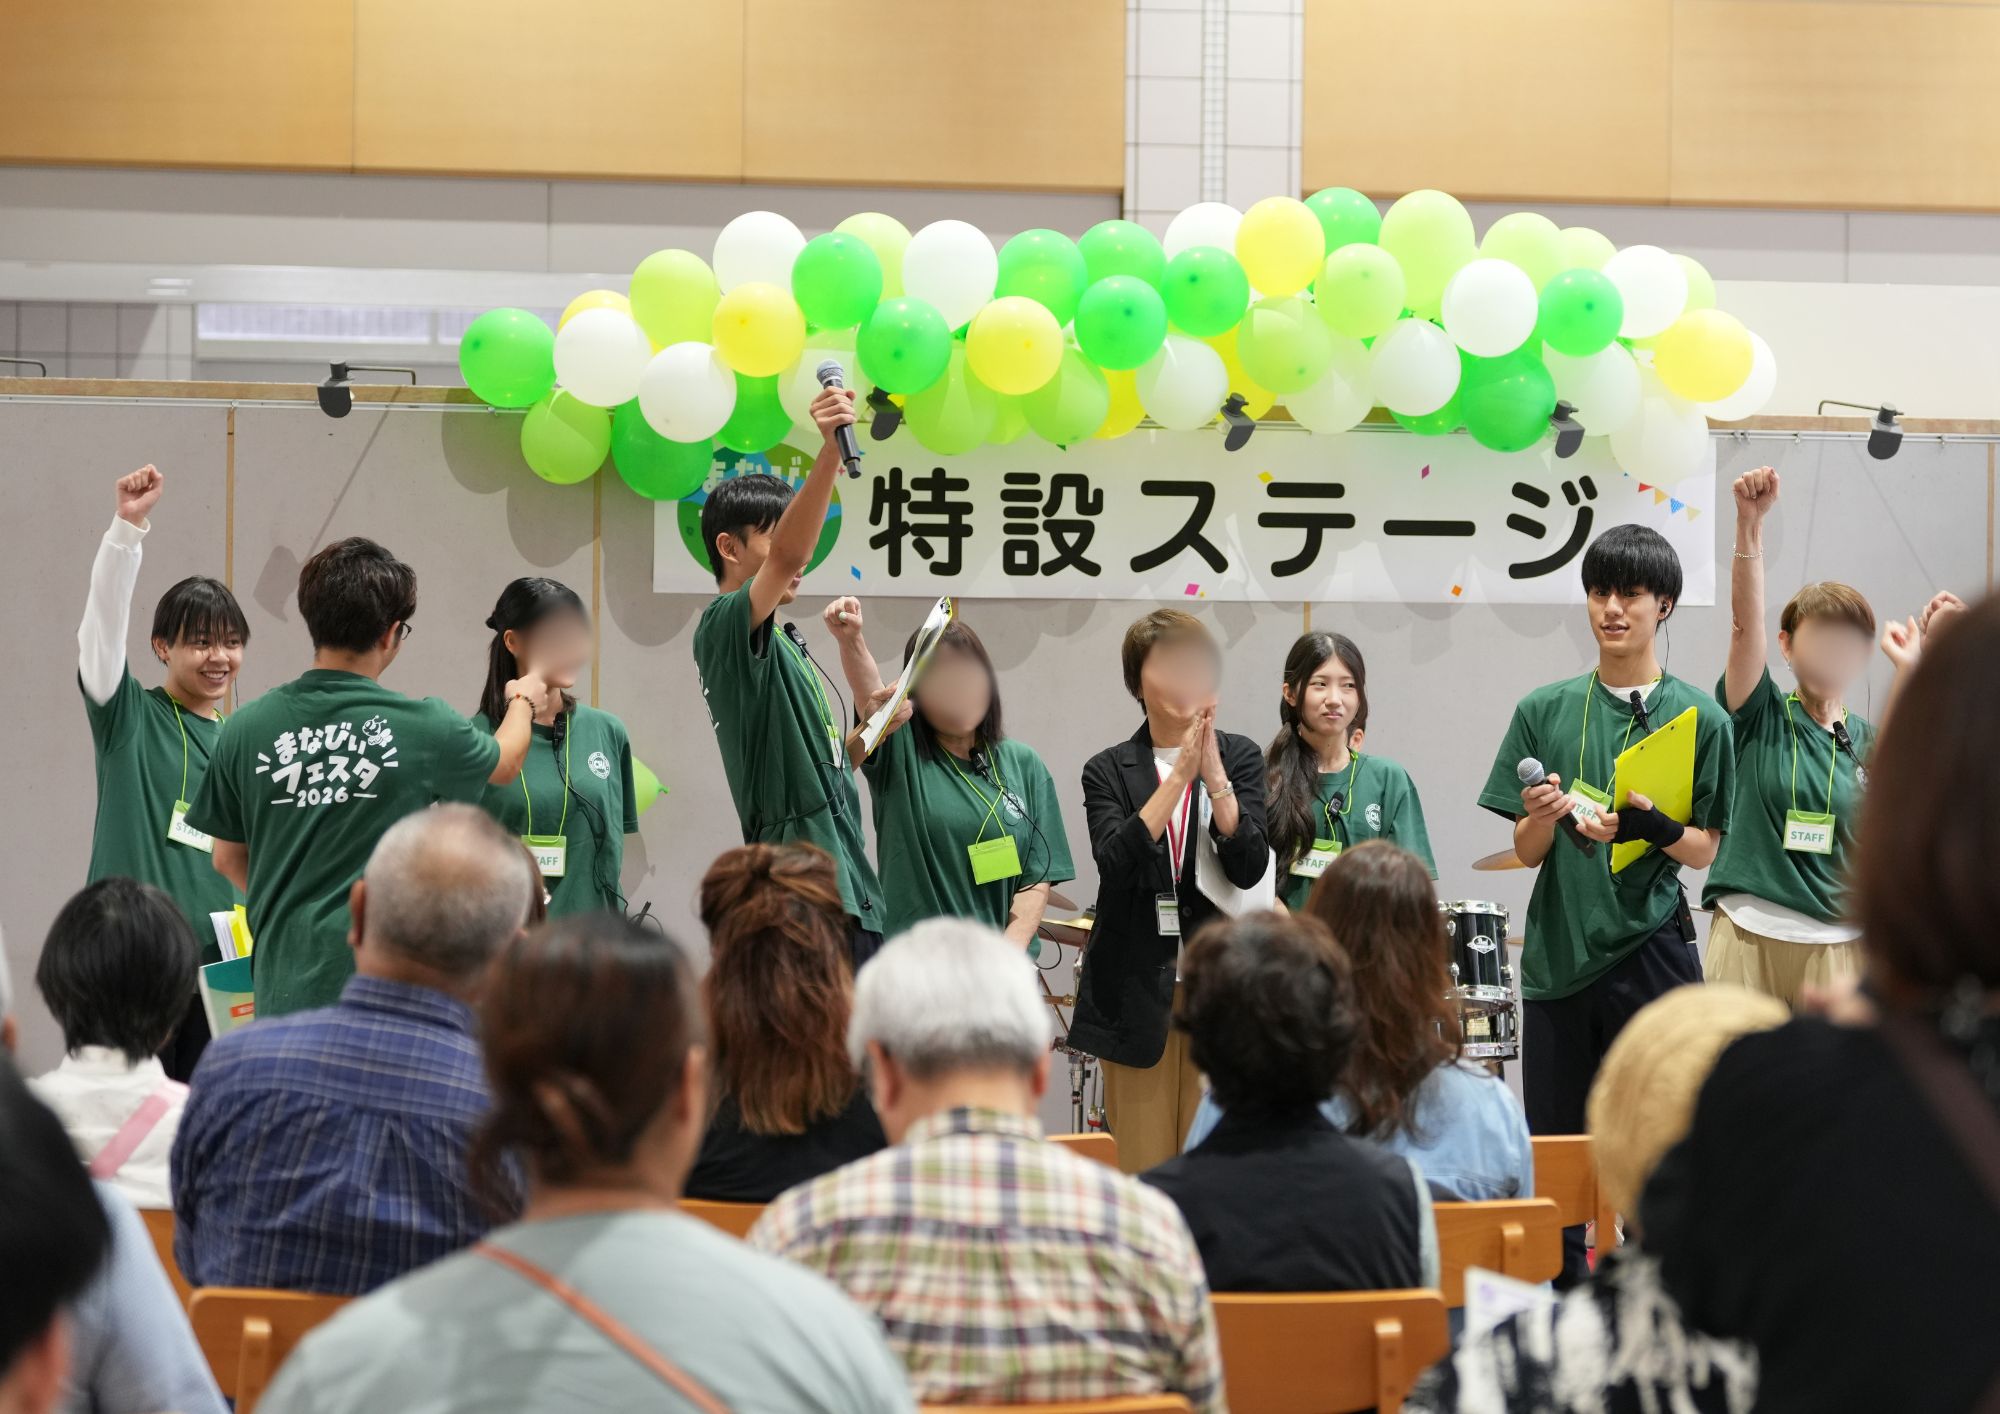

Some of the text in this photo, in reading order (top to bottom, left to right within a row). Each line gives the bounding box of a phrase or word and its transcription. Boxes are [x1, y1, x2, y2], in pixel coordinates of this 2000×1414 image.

[869, 467, 1598, 580] 特設ステージ
[271, 755, 381, 795] フェスタ
[297, 786, 349, 808] 2026
[1790, 830, 1825, 843] STAFF
